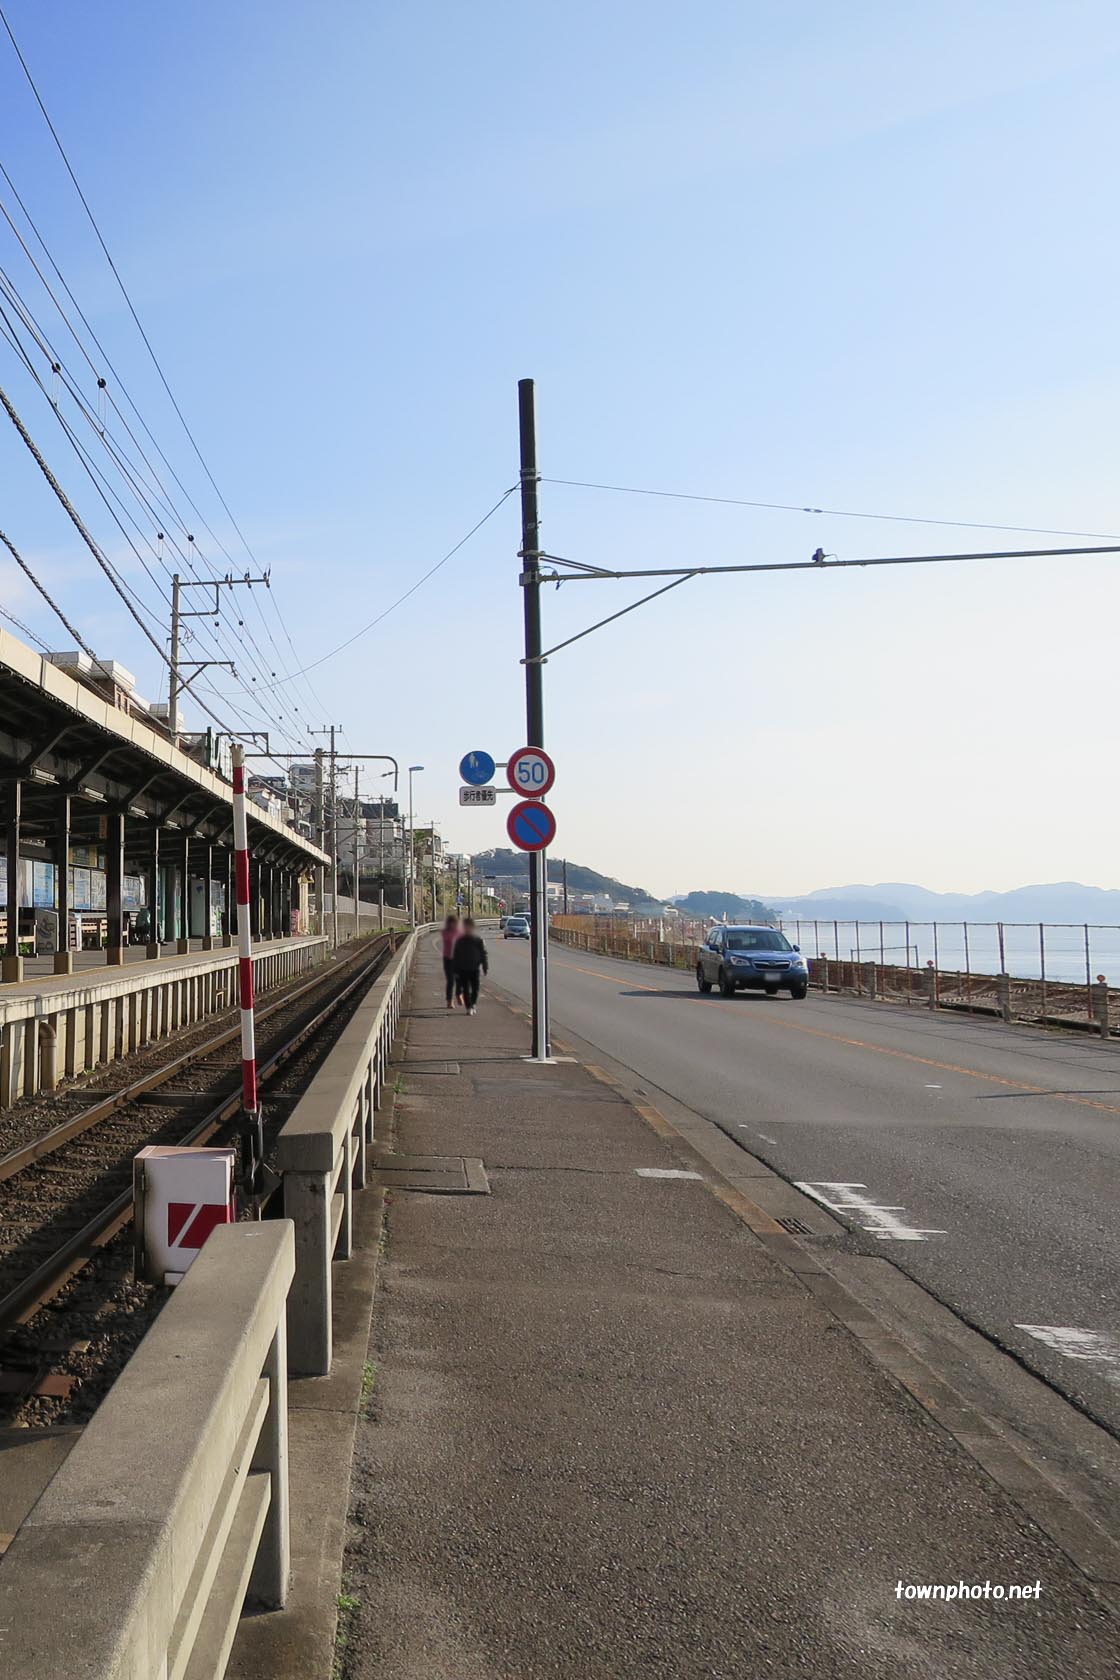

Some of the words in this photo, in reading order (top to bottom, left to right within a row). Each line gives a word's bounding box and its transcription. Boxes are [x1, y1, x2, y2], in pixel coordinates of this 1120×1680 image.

[518, 762, 544, 784] 50
[463, 789, 494, 802] 歩行者優先
